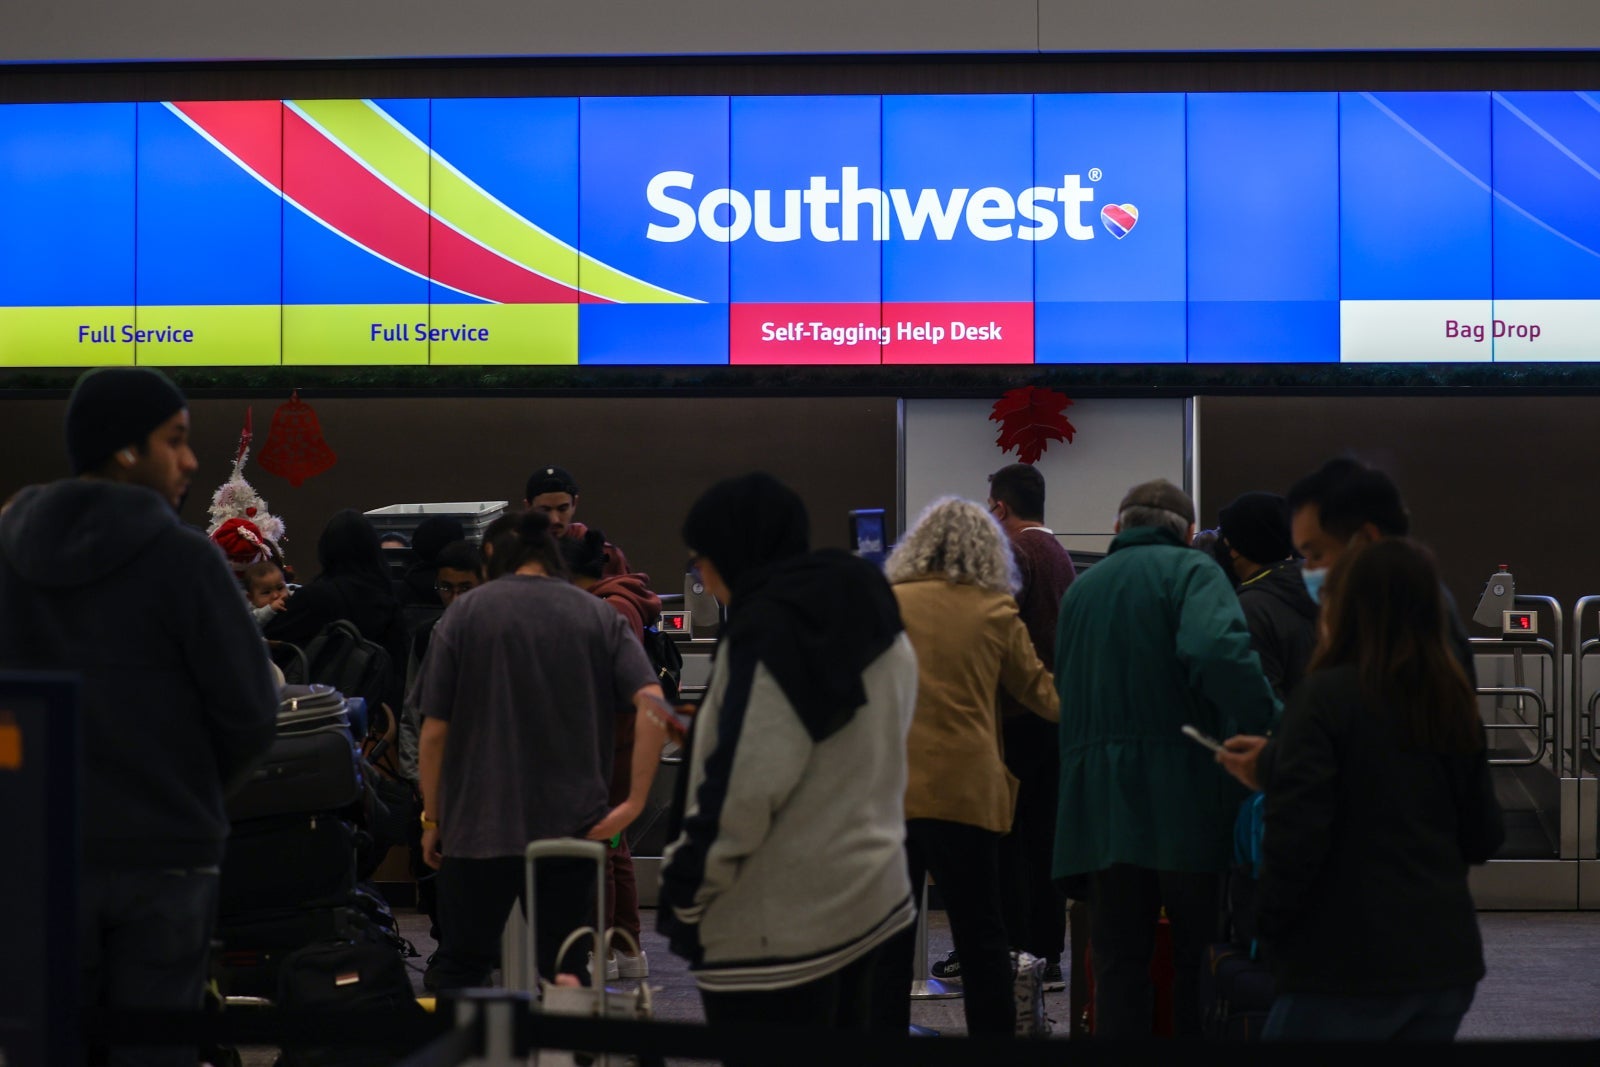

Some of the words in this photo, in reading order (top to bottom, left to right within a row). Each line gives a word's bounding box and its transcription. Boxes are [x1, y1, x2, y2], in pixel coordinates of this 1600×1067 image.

[78, 325, 117, 344] Full
[122, 325, 195, 344] Service
[371, 324, 410, 343] Full
[415, 324, 490, 343] Service
[761, 321, 892, 347] Self-Tagging
[897, 321, 946, 346] Help
[951, 321, 1003, 343] Desk
[1446, 320, 1486, 344] Bag
[1492, 320, 1542, 344] Drop
